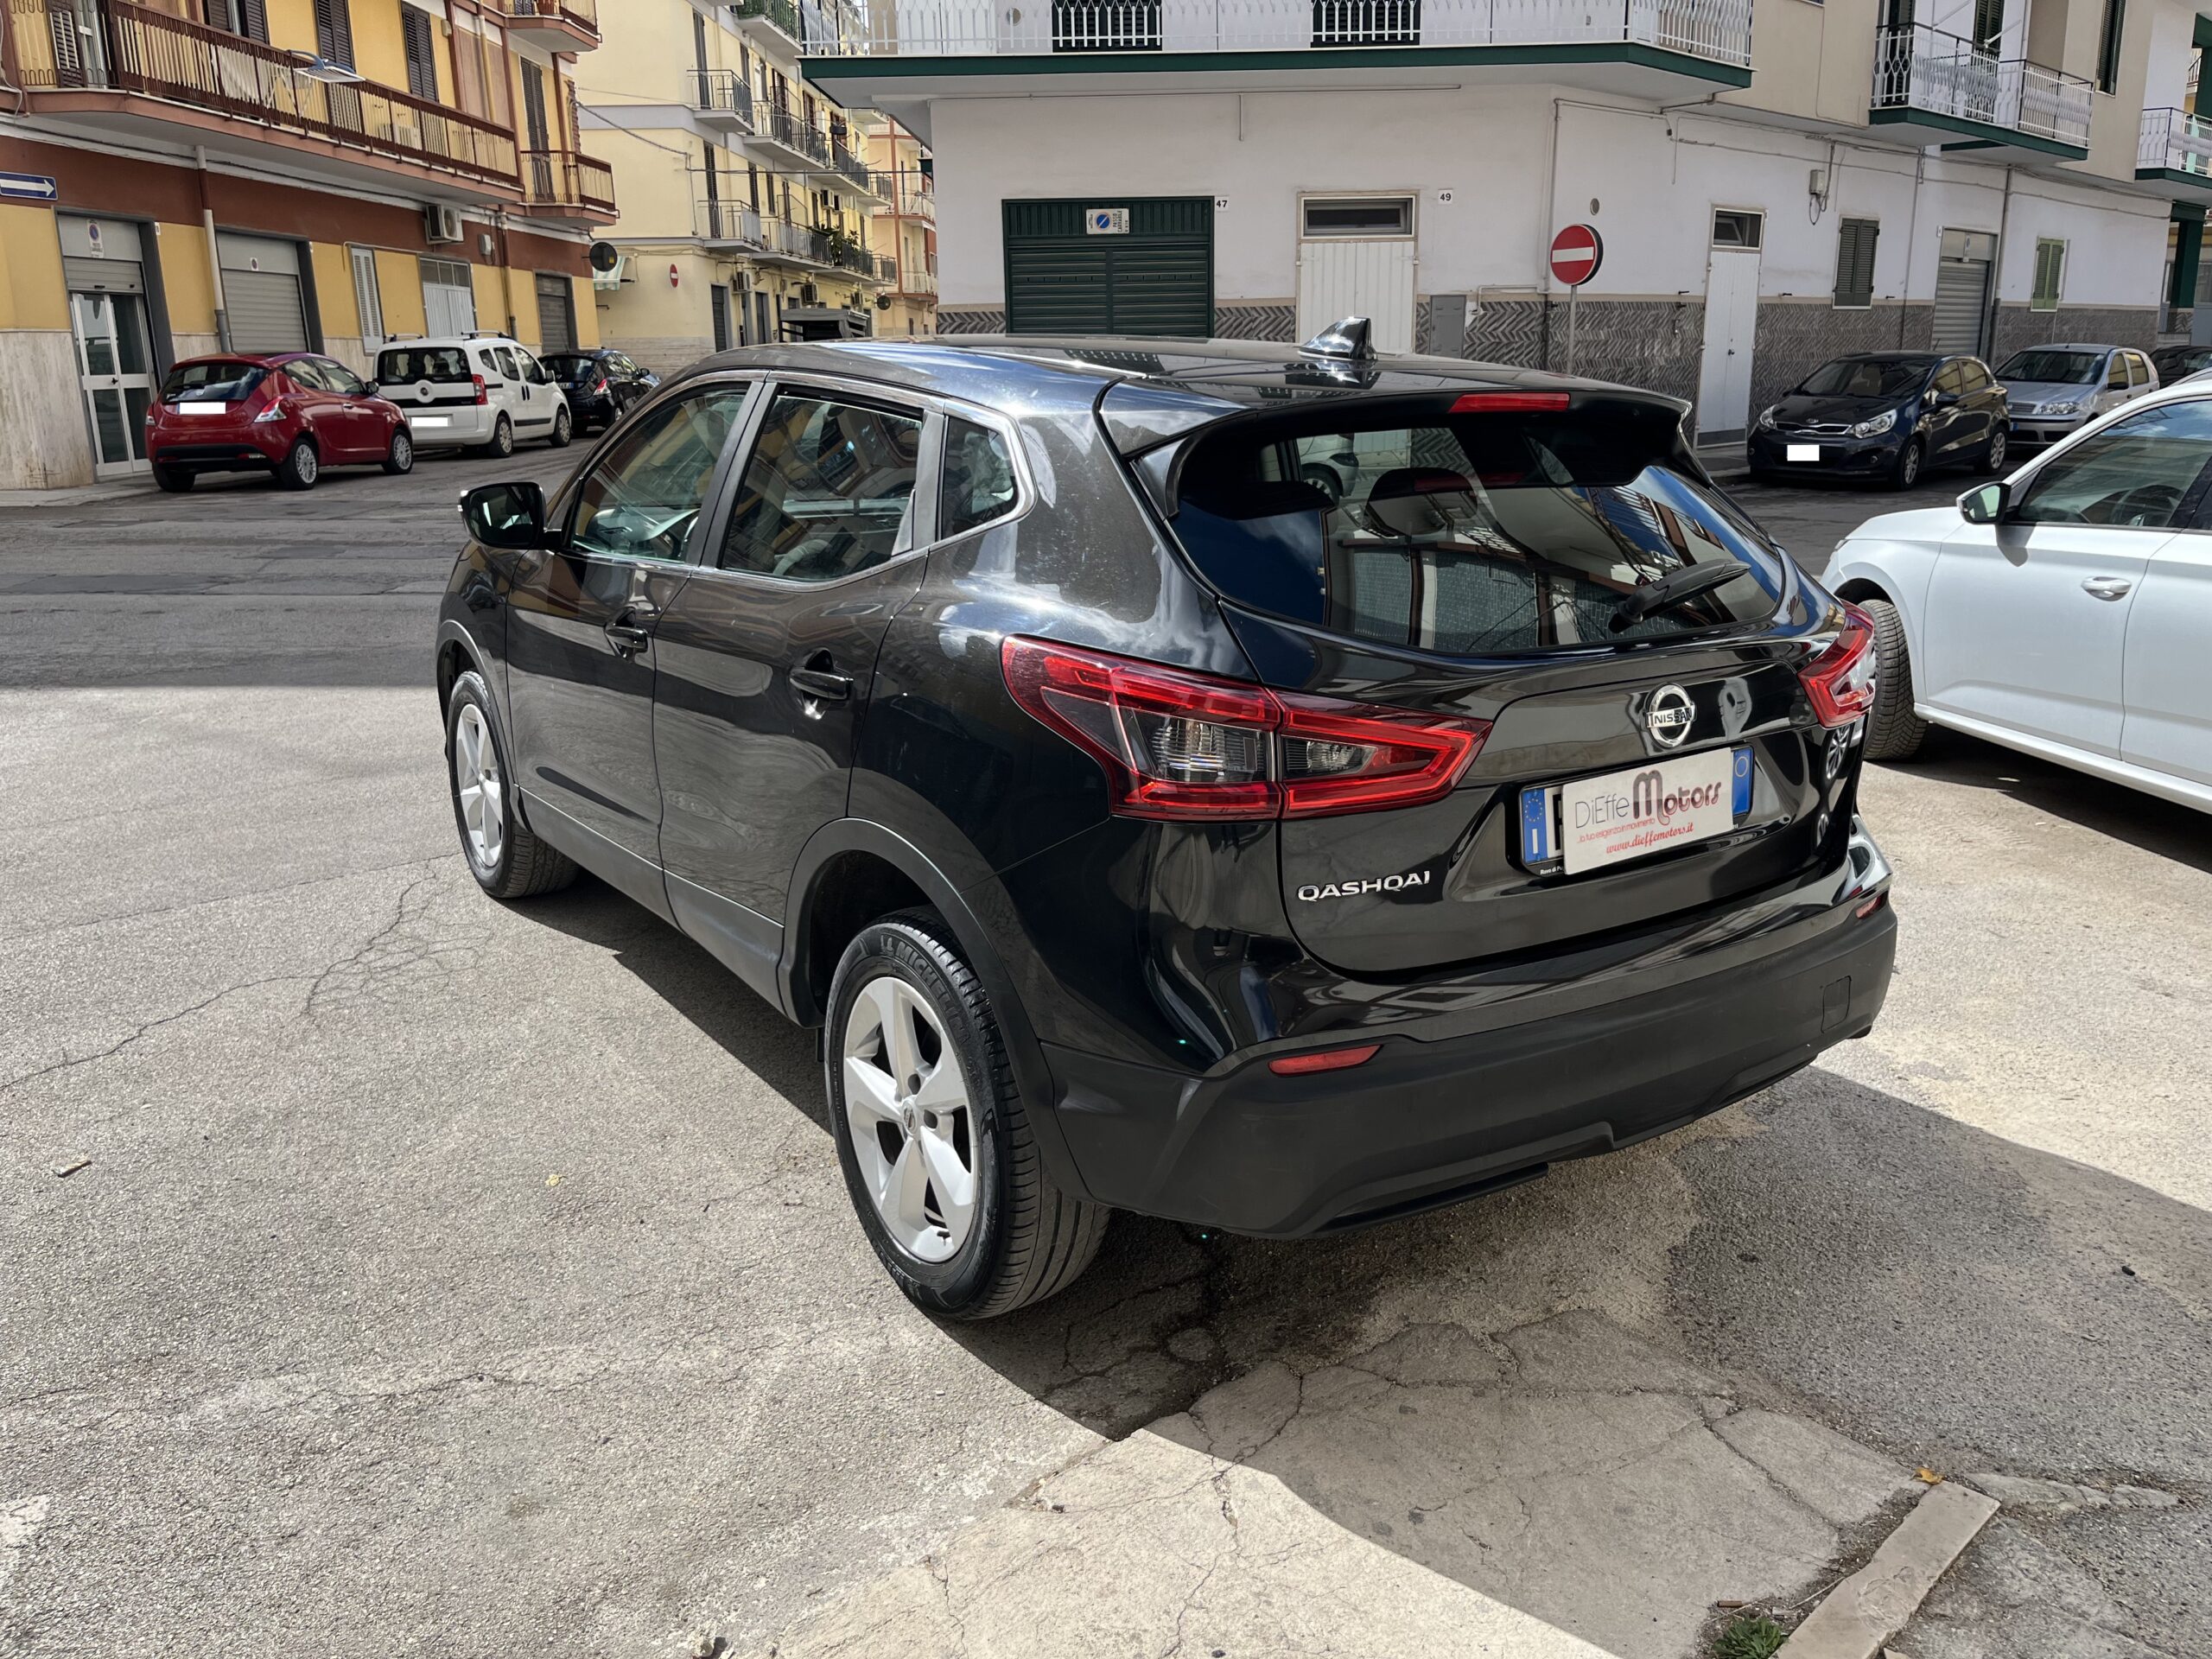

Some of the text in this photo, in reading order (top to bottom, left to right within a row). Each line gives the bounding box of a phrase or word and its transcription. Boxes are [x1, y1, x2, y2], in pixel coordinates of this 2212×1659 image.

[1216, 200, 1228, 208] 47
[1654, 709, 1693, 724] NISSAN
[1575, 792, 1630, 829] DiEffe
[1632, 769, 1722, 826] Motors
[1605, 822, 1694, 854] www.dieffemotors.it
[1298, 870, 1430, 902] QASHQAI
[895, 941, 972, 1046] MICHELIN
